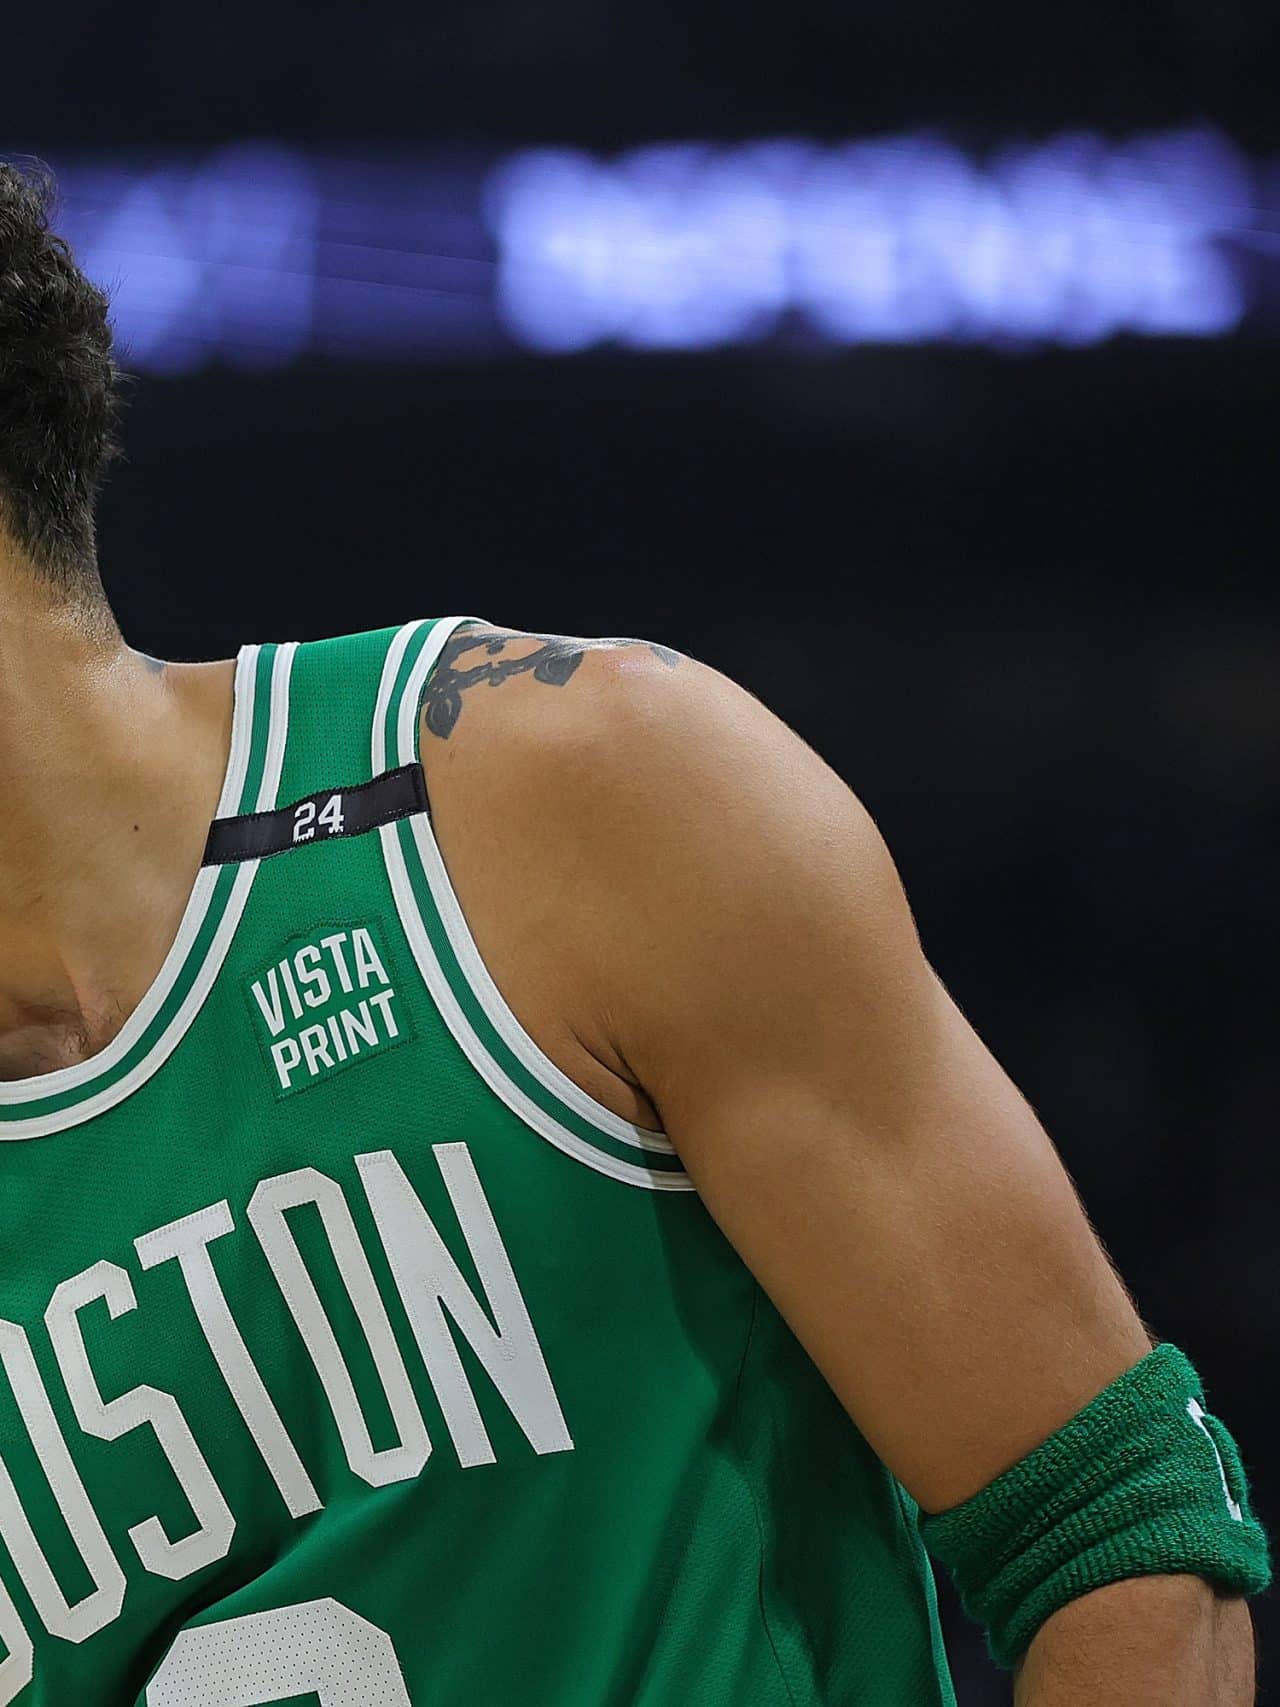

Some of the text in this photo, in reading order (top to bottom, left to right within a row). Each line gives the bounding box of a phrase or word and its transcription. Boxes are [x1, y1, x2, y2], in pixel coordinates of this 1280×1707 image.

[293, 794, 345, 842] 24
[251, 928, 391, 1037] VISTA
[270, 989, 400, 1090] PRINT
